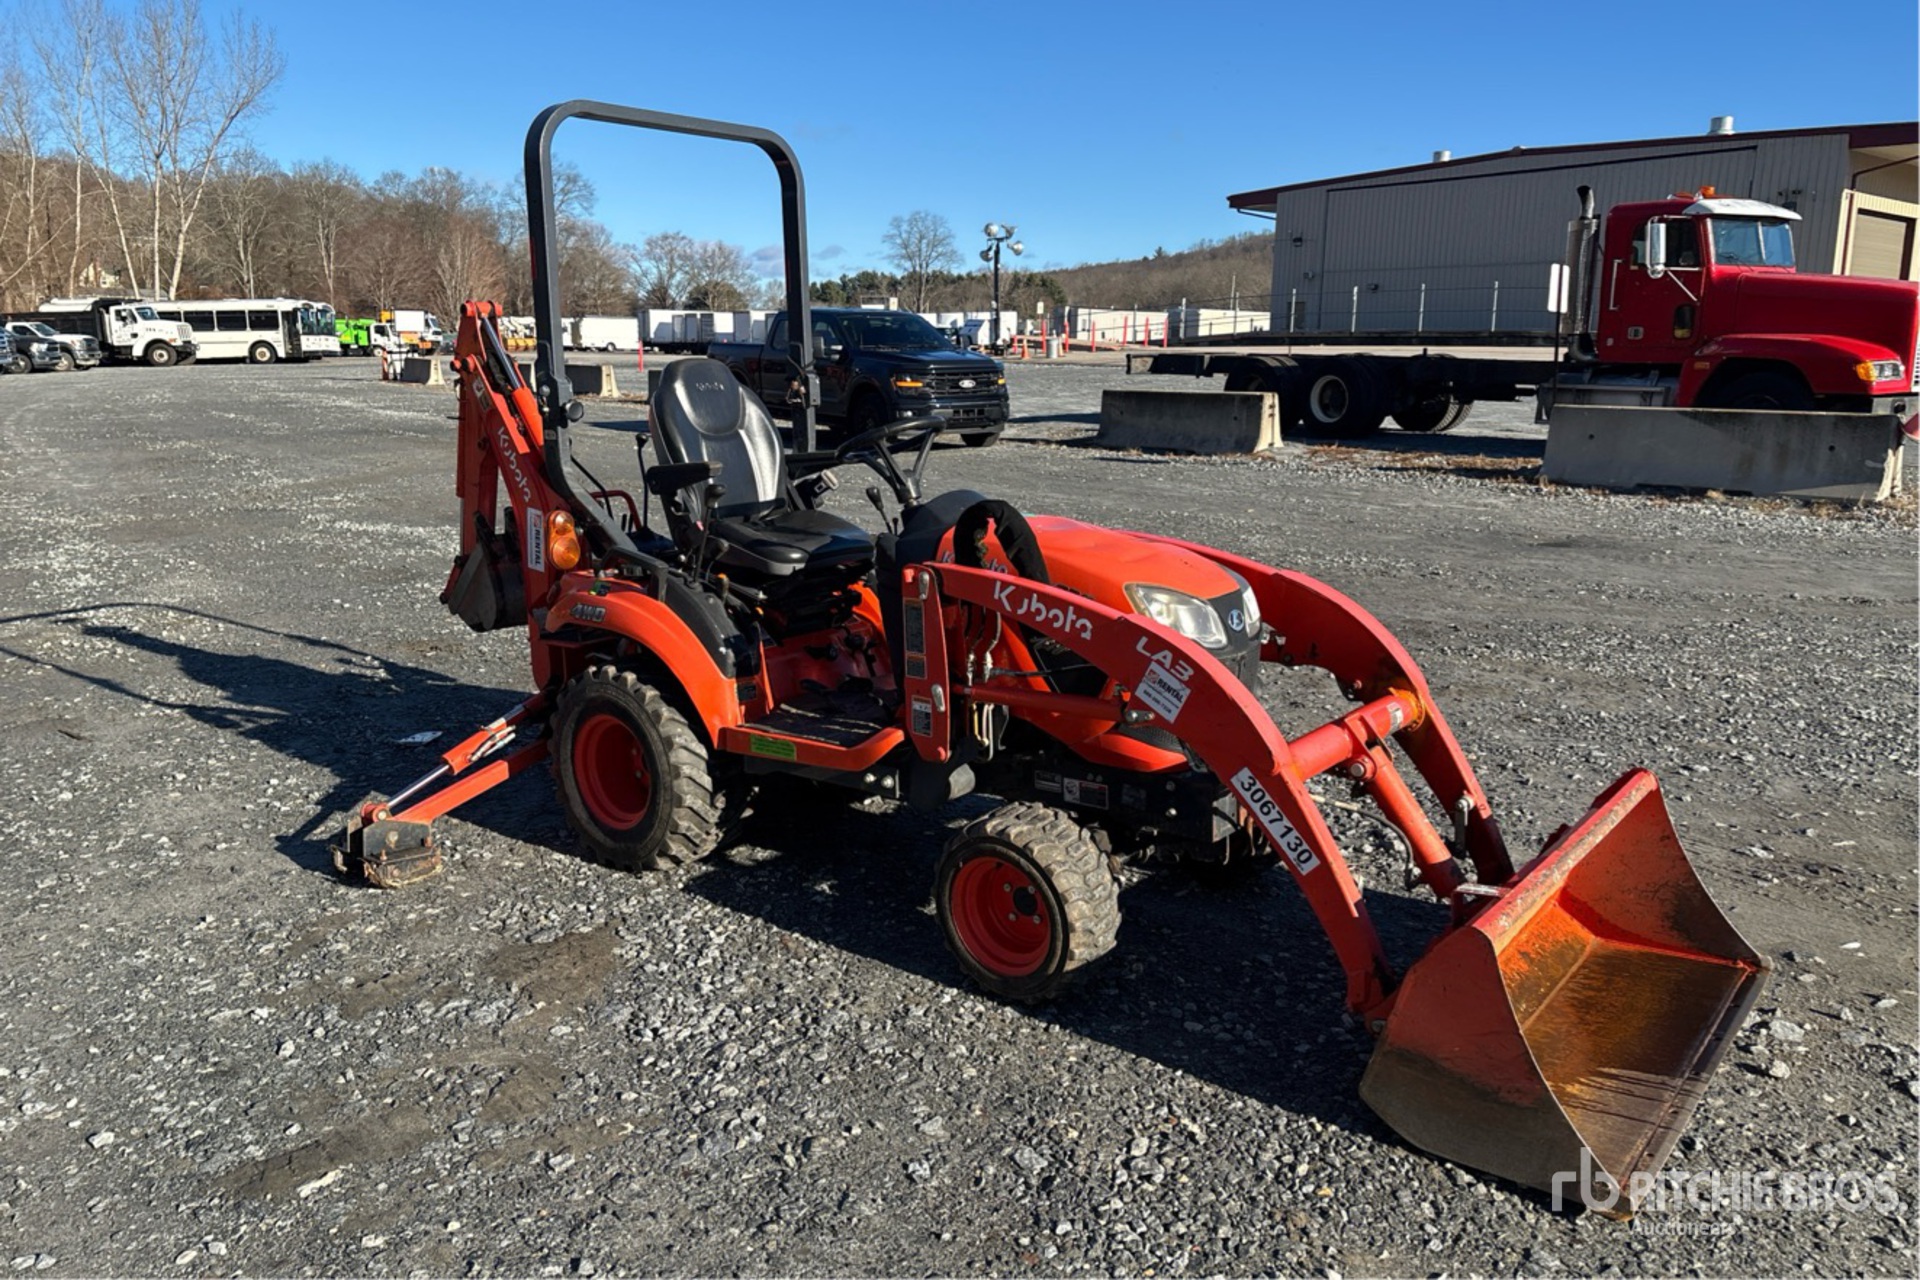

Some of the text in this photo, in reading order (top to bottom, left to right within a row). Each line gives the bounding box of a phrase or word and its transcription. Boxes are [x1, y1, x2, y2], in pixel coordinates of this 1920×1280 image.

[498, 427, 531, 502] Kubota
[570, 603, 606, 622] 4WD
[994, 580, 1093, 640] Kubota
[1157, 678, 1183, 703] RENTAL
[1240, 775, 1313, 864] 3067130
